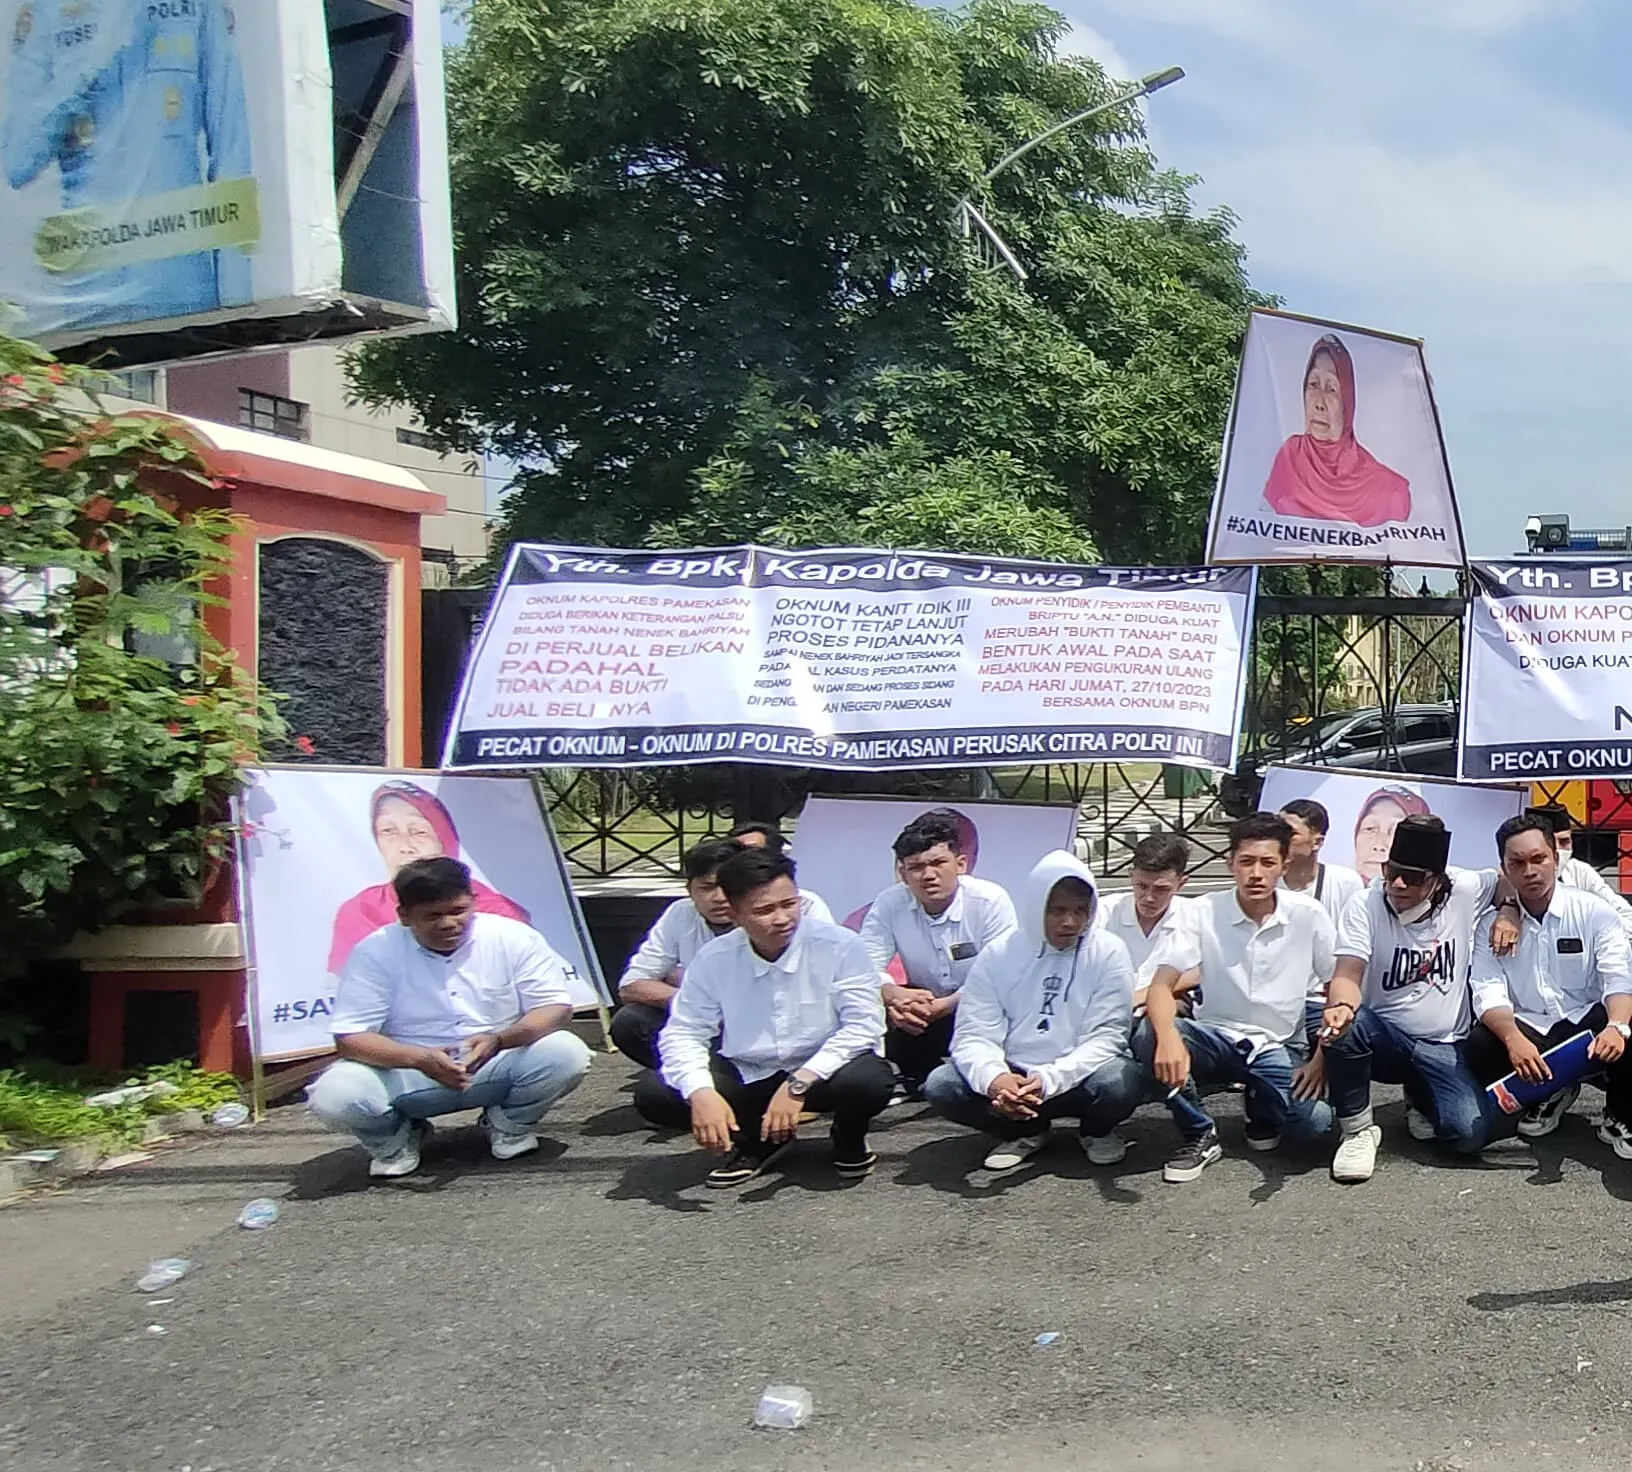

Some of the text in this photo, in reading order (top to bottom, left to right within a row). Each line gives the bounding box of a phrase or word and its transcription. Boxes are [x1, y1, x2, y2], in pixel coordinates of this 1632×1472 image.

[143, 214, 186, 238] JAWA
[189, 203, 240, 229] TIMUR
[1226, 515, 1446, 547] #SAVENENEKBAHRIYAH
[542, 553, 630, 575] Yth.
[764, 558, 953, 585] Kapolda
[963, 565, 1083, 588] Jawa
[1486, 565, 1573, 590] Yth.
[526, 595, 751, 608] OKNUM KAPOLRES PAMEKASAN
[776, 598, 971, 617] OKNUM KANIT IDIK III
[991, 596, 1033, 607] OKNUM
[1036, 597, 1091, 608] PENYIDIK
[1100, 600, 1155, 609] PENYIDIK
[1157, 599, 1222, 614] PEMBANTU
[519, 610, 563, 621] DIDUGA
[566, 610, 619, 621] BERIKAN
[622, 612, 705, 624] KETERANGAN
[1124, 614, 1178, 625] DIDUGA
[1182, 618, 1220, 628] KUAT
[1489, 604, 1567, 623] OKNUM
[513, 625, 751, 638] BILANG TANAH NENEK BAHRIYAH
[771, 613, 968, 633] NGOTOT TETAP LANJUT
[767, 630, 964, 649] PROSES PIDANANYA
[984, 626, 1059, 639] MERUBAH
[1181, 632, 1218, 645] DARI
[1547, 629, 1615, 644] OKNUM
[505, 641, 745, 658] DI PERJUAL BELIKAN
[800, 651, 833, 661] NENEK
[835, 652, 882, 662] BAHRIYAH
[884, 652, 904, 661] JADI
[905, 650, 961, 659] TERSANGKA
[982, 643, 1215, 663] BENTUK AWAL PADA SAAT
[499, 660, 664, 677] PADAHAL
[759, 662, 791, 672] PADA
[824, 667, 869, 676] KASUS
[872, 664, 957, 676] PERDATANYA
[978, 662, 1213, 680] MELAKUKAN PENGUKURAN ULANG
[497, 678, 669, 695] TIDAK ADA BUKTI
[754, 678, 792, 689] SEDANG
[826, 683, 844, 693] DAN
[845, 683, 882, 692] SEDANG
[884, 681, 920, 691] PROSES
[981, 679, 1211, 697] PADA HARI JUMAT, 27/10/2023
[487, 701, 538, 718] JUAL
[747, 695, 761, 706] DI
[840, 700, 882, 712] NEGERI
[883, 698, 952, 711] PAMEKASAN
[1043, 697, 1210, 713] BERSAMA OKNUM BPN
[479, 737, 547, 757] PECAT
[550, 736, 626, 756] OKNUM
[642, 735, 712, 755] OKNUM
[715, 732, 736, 751] DI
[739, 732, 827, 757] POLRES
[830, 736, 949, 759] PAMEKASAN
[952, 733, 1045, 756] PERUSAK
[1048, 733, 1111, 755] CITRA
[1112, 733, 1172, 754] POLRI
[1176, 736, 1203, 757] INI
[1490, 750, 1562, 771] PECAT
[1040, 993, 1055, 1016] K
